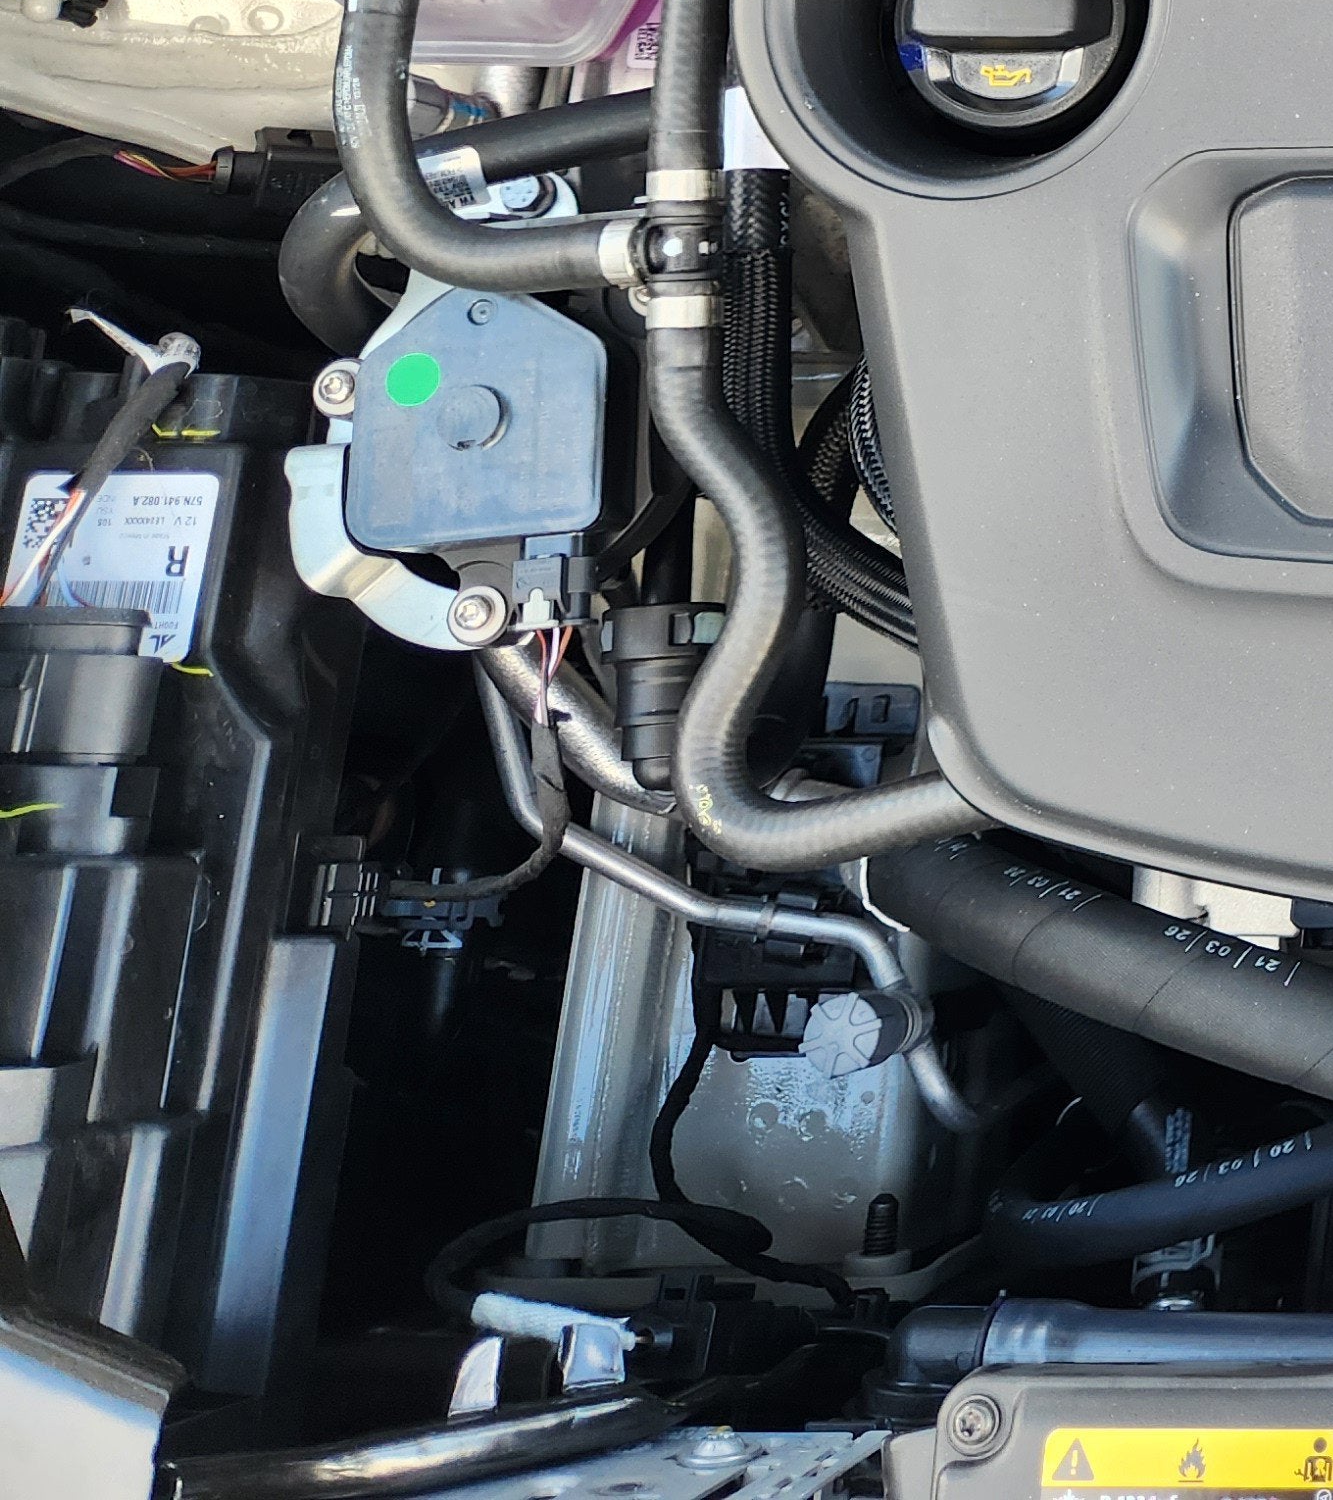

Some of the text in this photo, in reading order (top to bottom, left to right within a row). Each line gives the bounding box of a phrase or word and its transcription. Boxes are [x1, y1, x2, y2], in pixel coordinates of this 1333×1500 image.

[165, 546, 189, 577] R
[1164, 925, 1282, 972] 21 03 26
